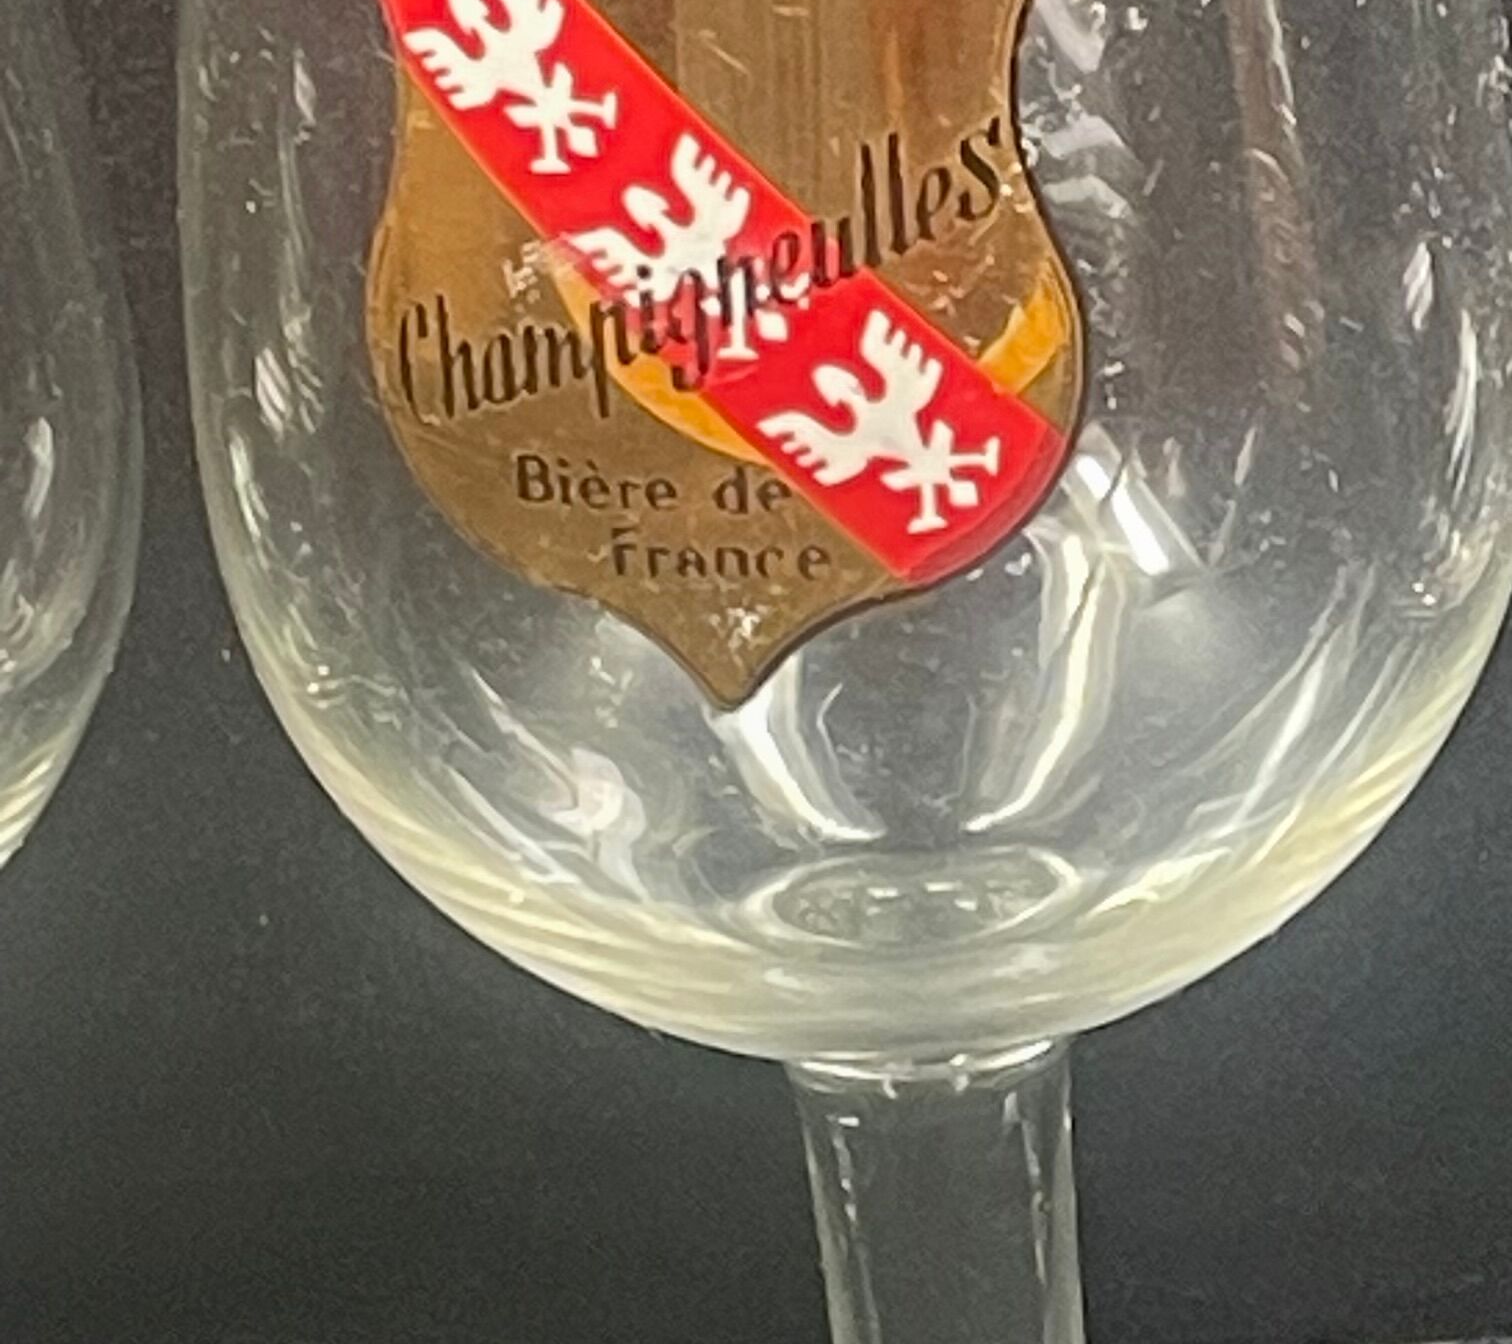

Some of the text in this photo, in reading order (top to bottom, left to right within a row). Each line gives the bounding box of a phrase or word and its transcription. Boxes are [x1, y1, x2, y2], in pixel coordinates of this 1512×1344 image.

[400, 116, 1002, 424] Champigneulles
[516, 455, 793, 513] Bière de
[612, 528, 831, 580] France
